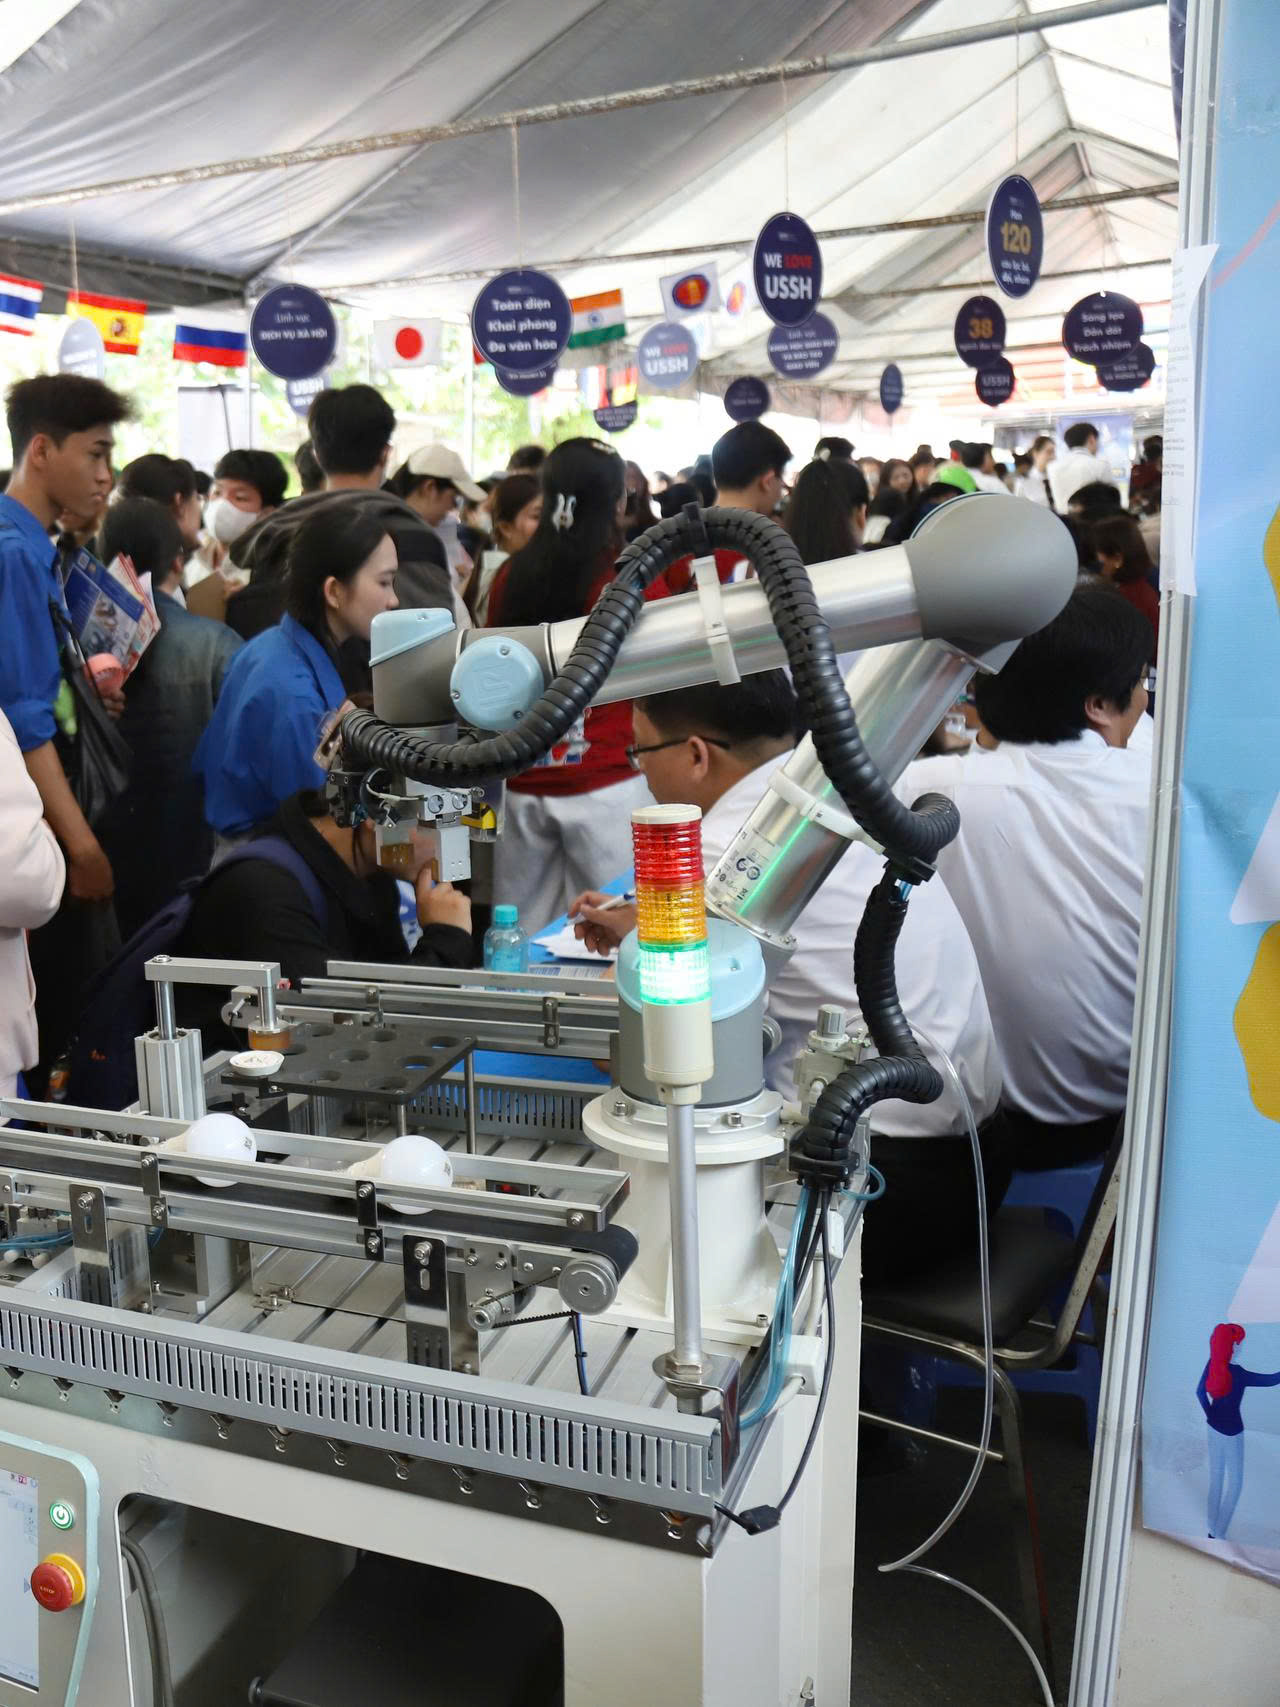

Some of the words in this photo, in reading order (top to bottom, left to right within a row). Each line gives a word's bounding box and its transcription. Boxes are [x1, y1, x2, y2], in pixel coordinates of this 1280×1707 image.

[1001, 221, 1031, 256] 120
[763, 253, 782, 268] WE
[765, 275, 813, 300] USSH
[644, 357, 688, 376] USSH
